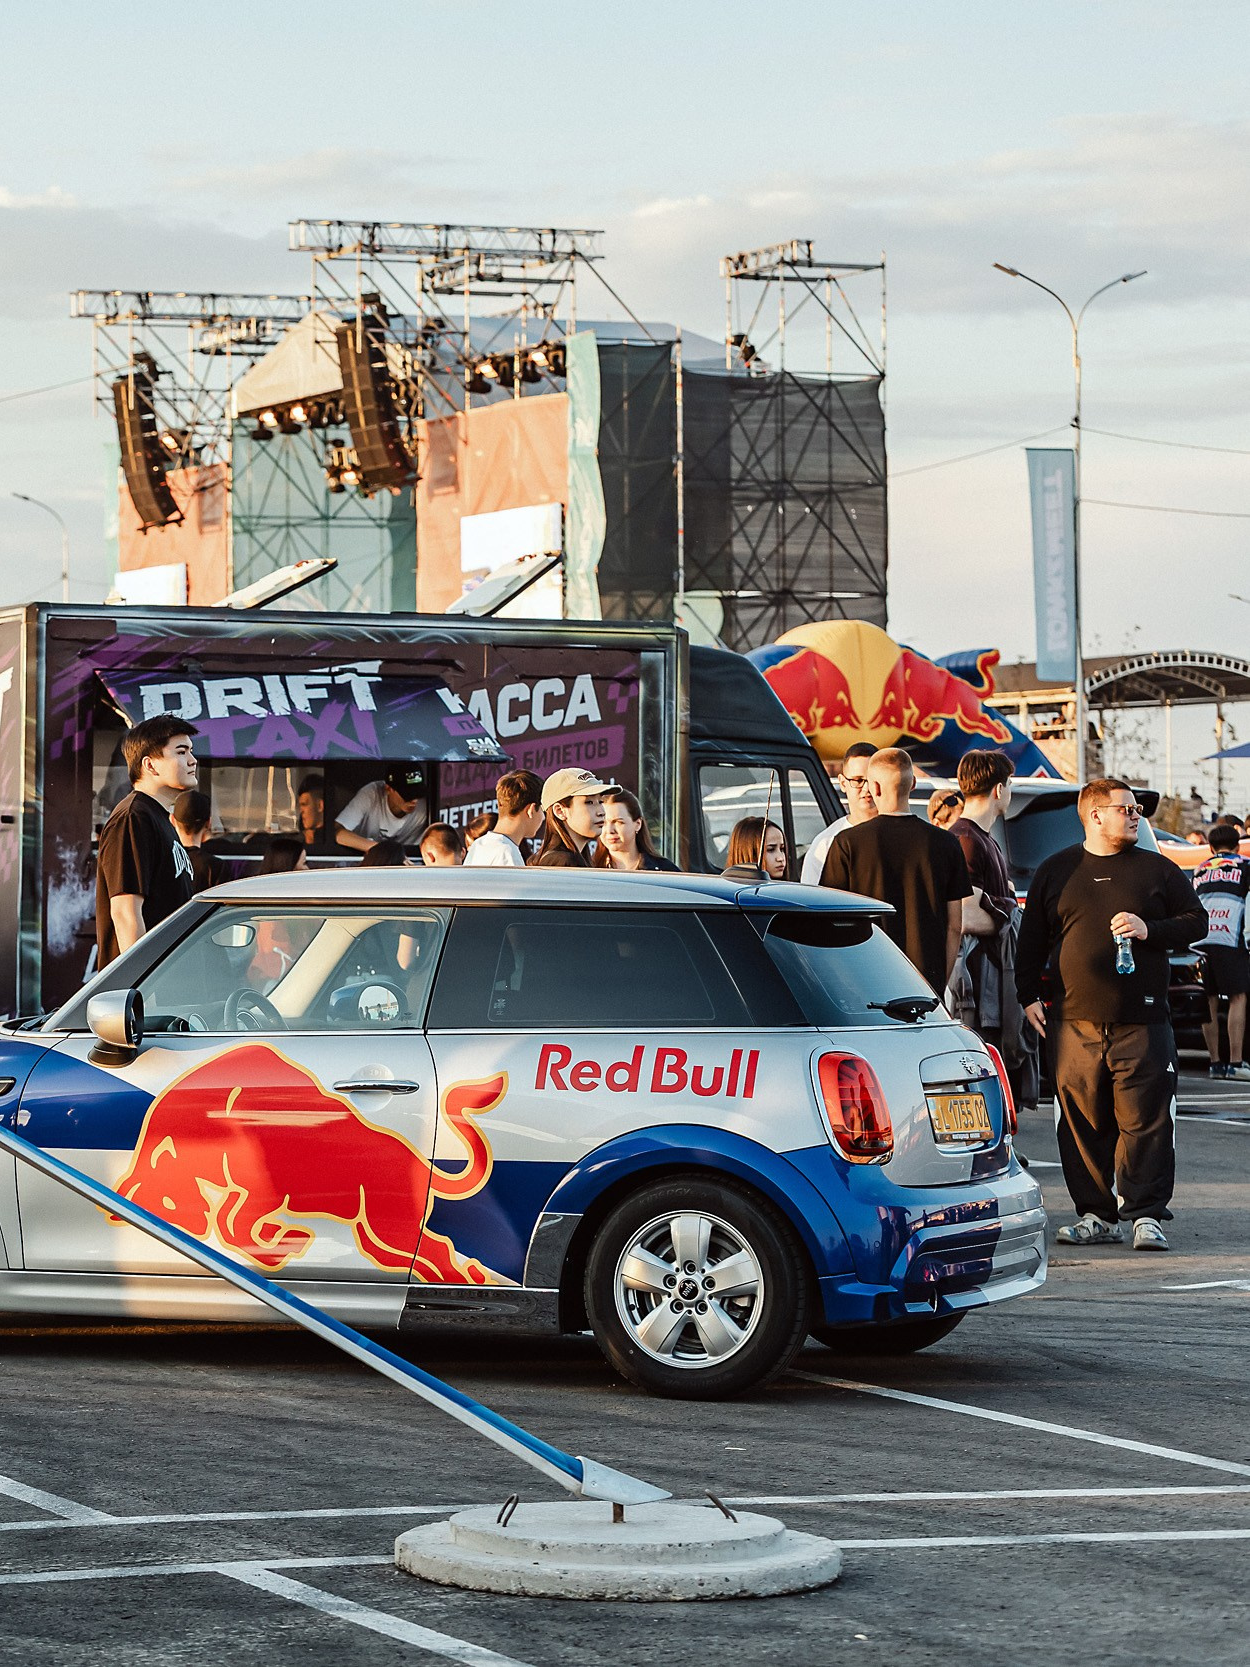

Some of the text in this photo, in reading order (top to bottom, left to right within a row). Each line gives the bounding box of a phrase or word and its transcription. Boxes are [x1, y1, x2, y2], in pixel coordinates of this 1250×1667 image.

[139, 660, 383, 720] DRIFT
[189, 700, 382, 759] TAXI
[522, 738, 609, 771] БИЛЕТОВ
[1211, 868, 1242, 884] Bull
[535, 1044, 760, 1098] Red Bull
